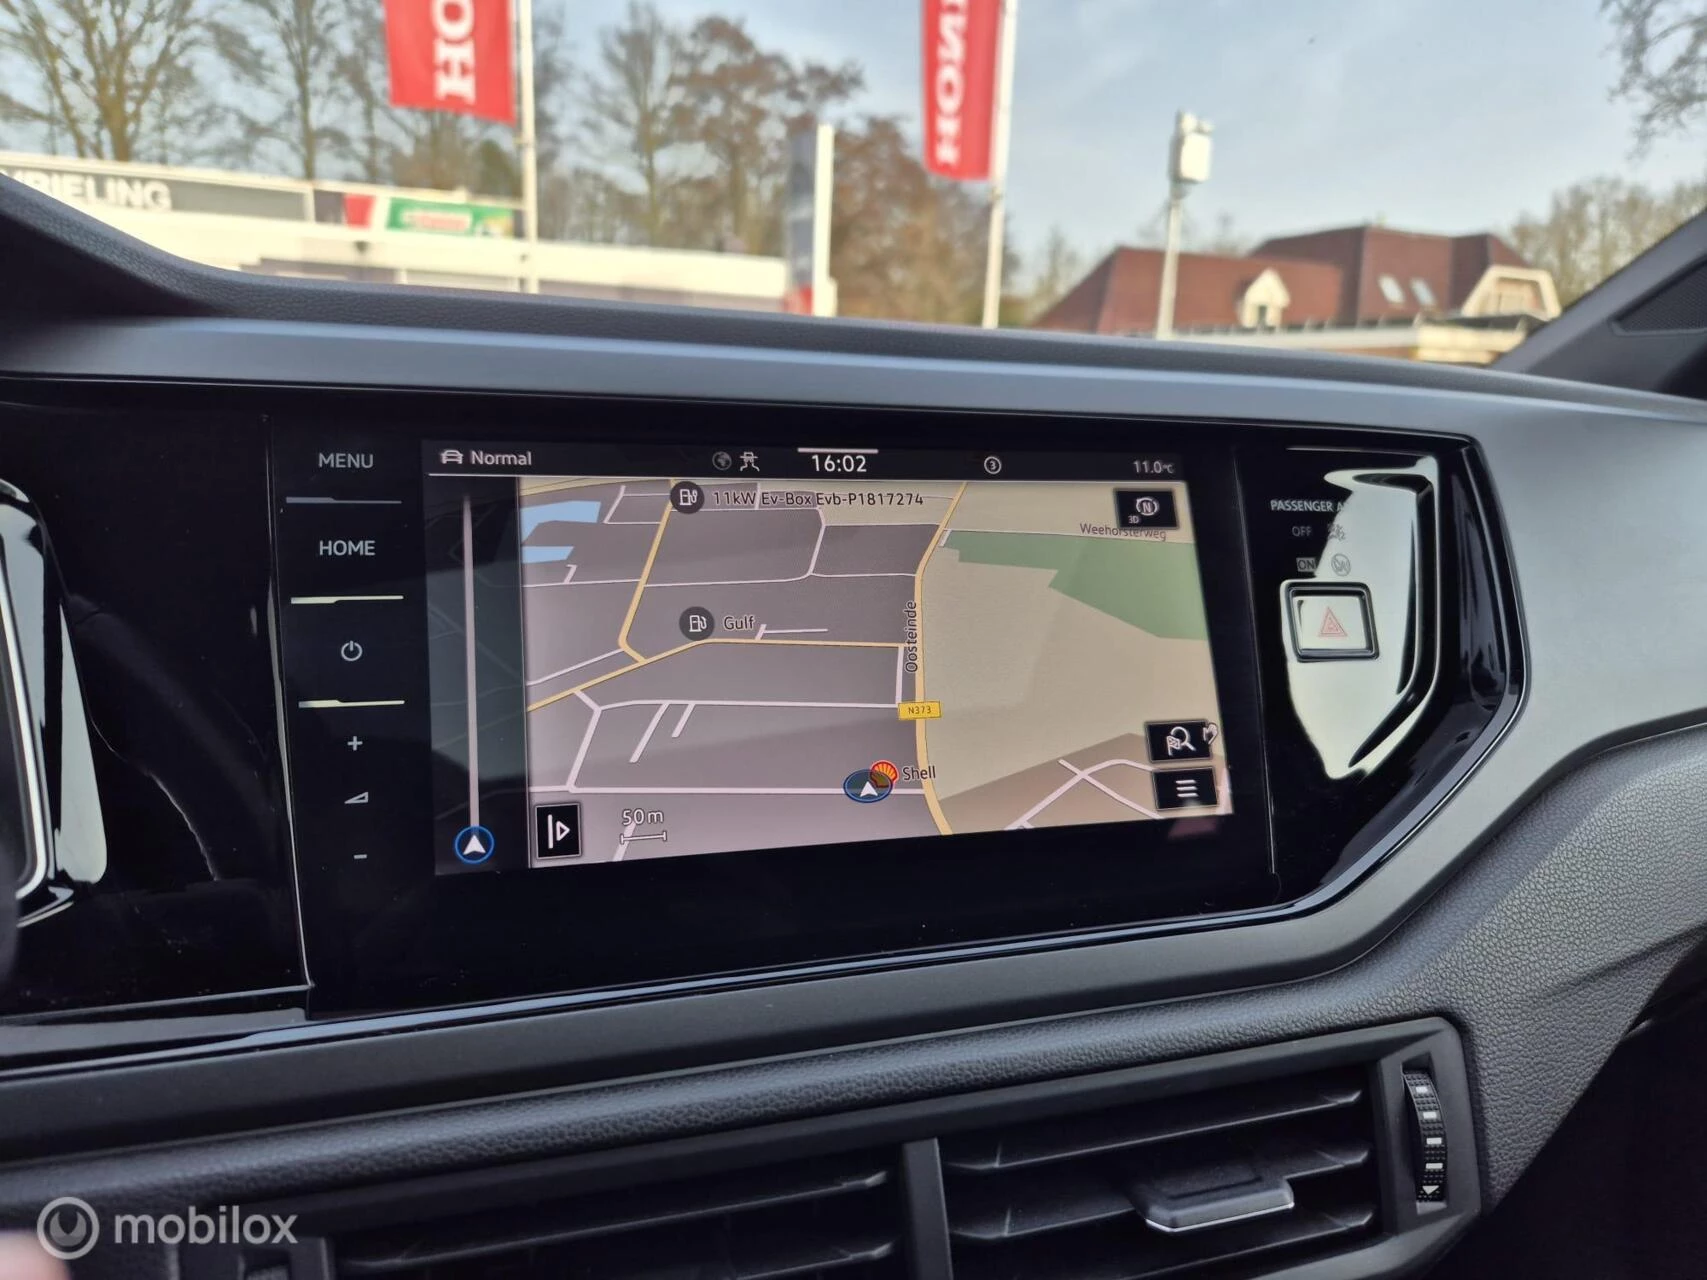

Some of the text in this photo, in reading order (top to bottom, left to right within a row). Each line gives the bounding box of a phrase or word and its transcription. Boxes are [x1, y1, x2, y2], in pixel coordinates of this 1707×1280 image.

[318, 452, 374, 469] MENU
[471, 450, 532, 466] Normal
[811, 454, 867, 473] 16:02
[713, 491, 924, 507] 11kW Ev-Box Evb-P1817274
[1270, 500, 1334, 512] PASSENGER
[1128, 515, 1140, 524] 3D
[1291, 526, 1312, 537] OFF
[319, 540, 376, 556] HOME
[1297, 559, 1316, 571] ON
[723, 615, 756, 632] Gulf
[905, 600, 918, 673] Oosteinde
[907, 705, 932, 716] N373
[902, 765, 937, 781] Shell
